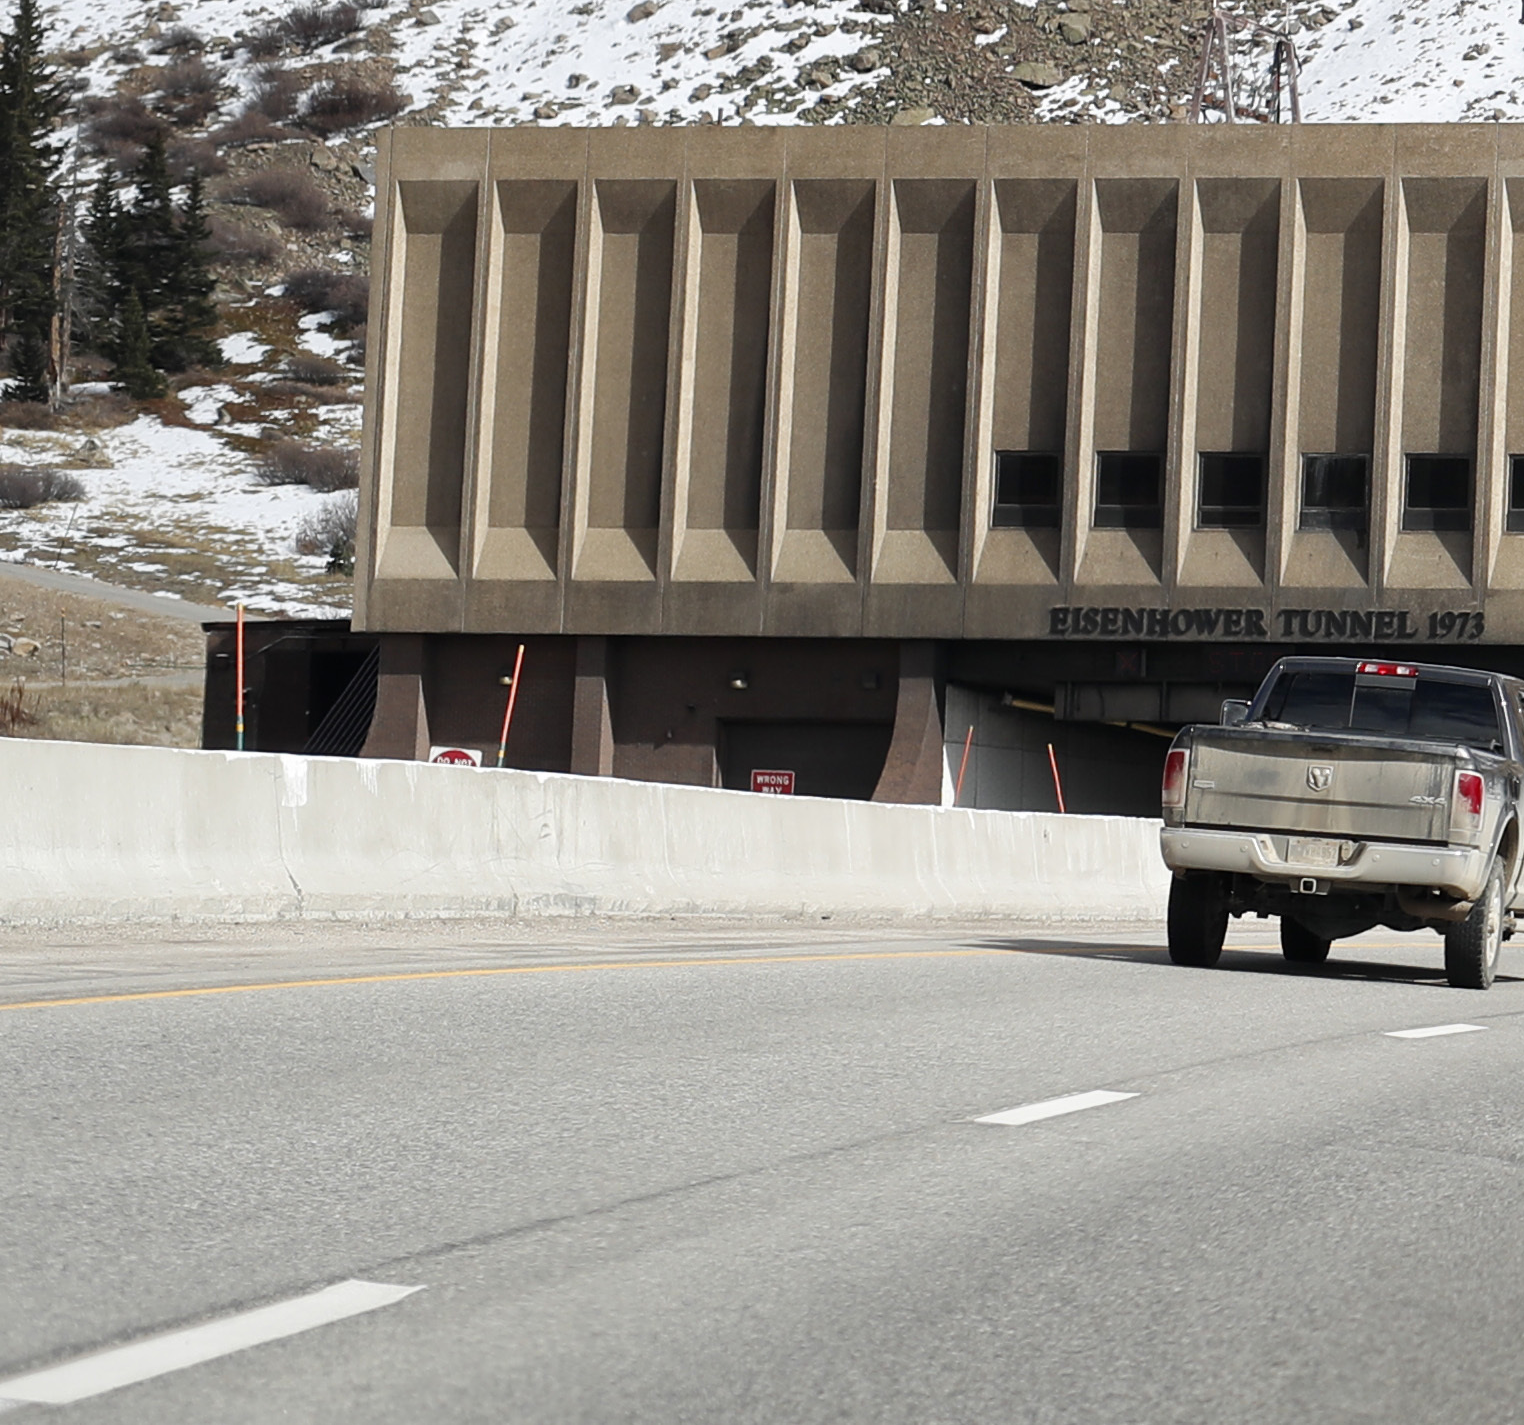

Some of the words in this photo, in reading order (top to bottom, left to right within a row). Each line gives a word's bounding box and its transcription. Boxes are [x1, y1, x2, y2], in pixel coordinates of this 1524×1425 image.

[1048, 606, 1269, 637] EISENHOWER
[1275, 608, 1418, 640] TUNNEL
[1427, 610, 1486, 640] 1973
[756, 775, 789, 785] WRONG
